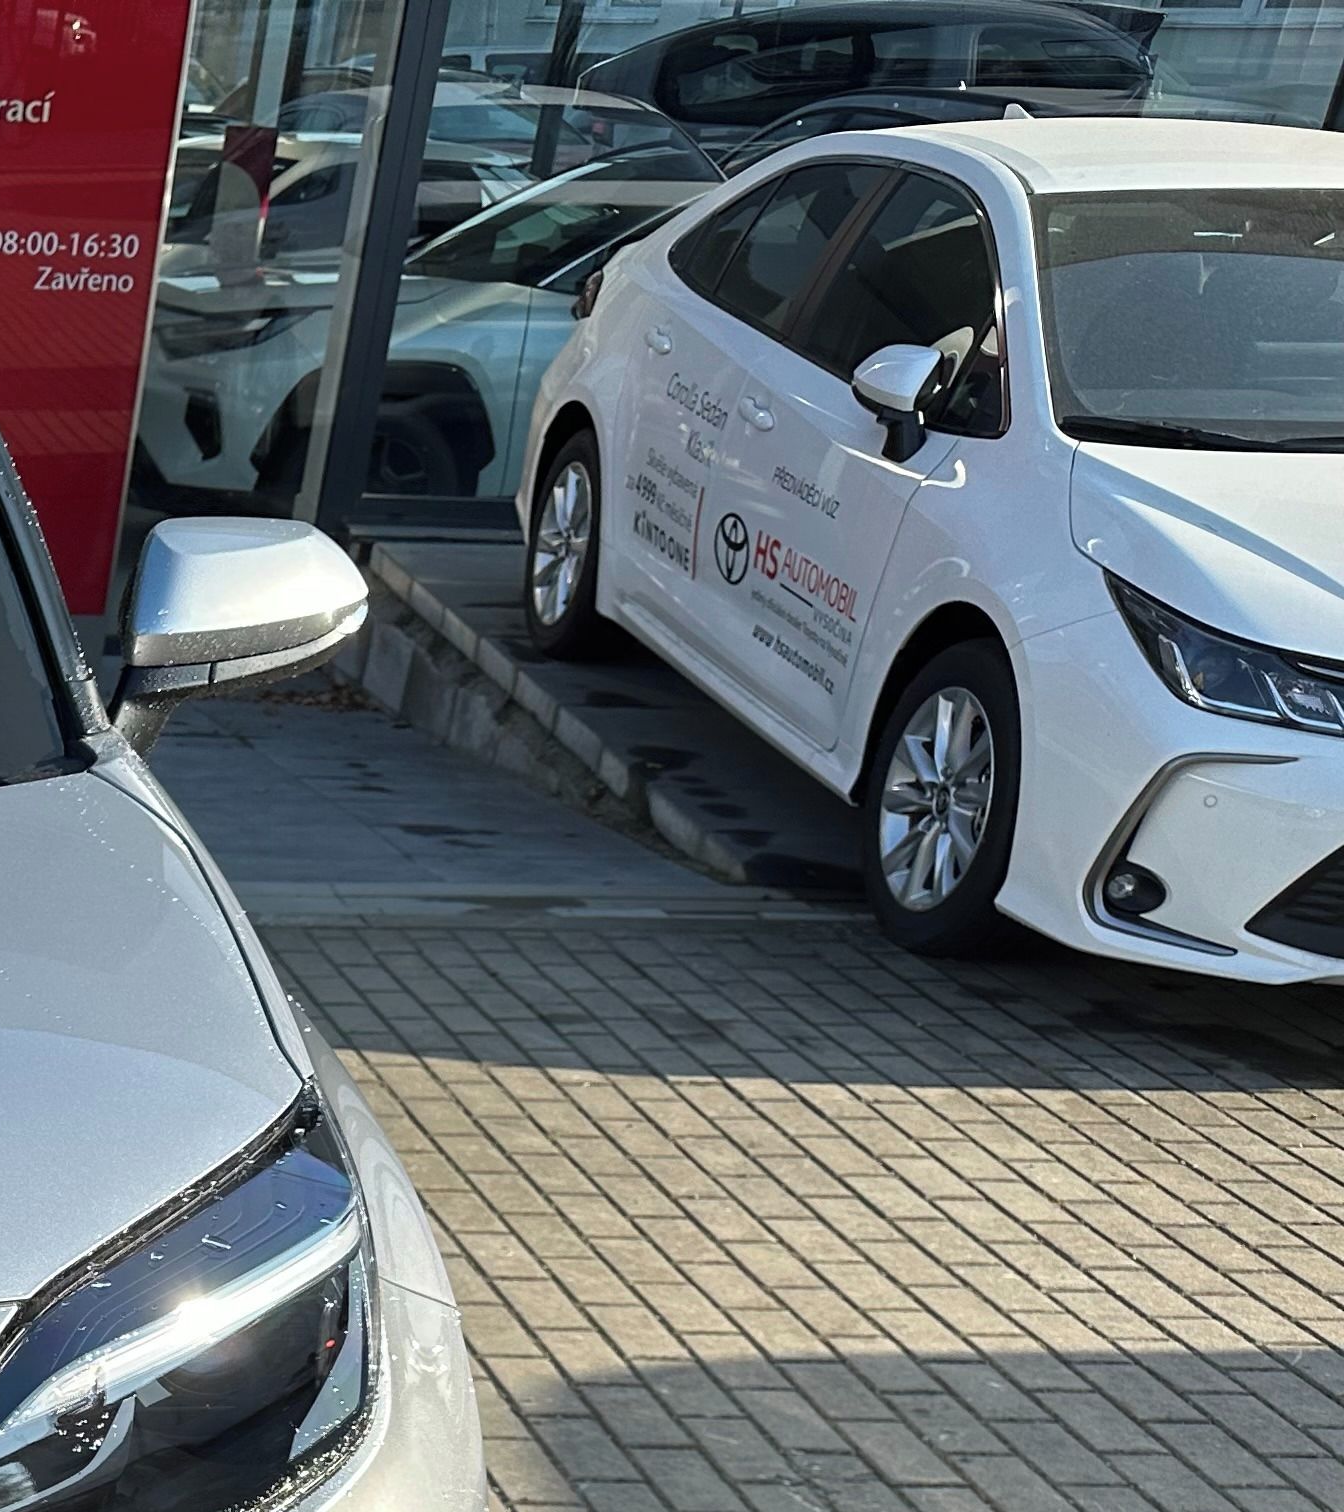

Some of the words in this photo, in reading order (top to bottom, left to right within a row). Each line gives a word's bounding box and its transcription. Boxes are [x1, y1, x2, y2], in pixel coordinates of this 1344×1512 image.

[34, 266, 134, 292] Zavřeno
[667, 534, 690, 573] ONE
[754, 530, 781, 580] HS
[781, 547, 858, 622] AUTOMOBIL
